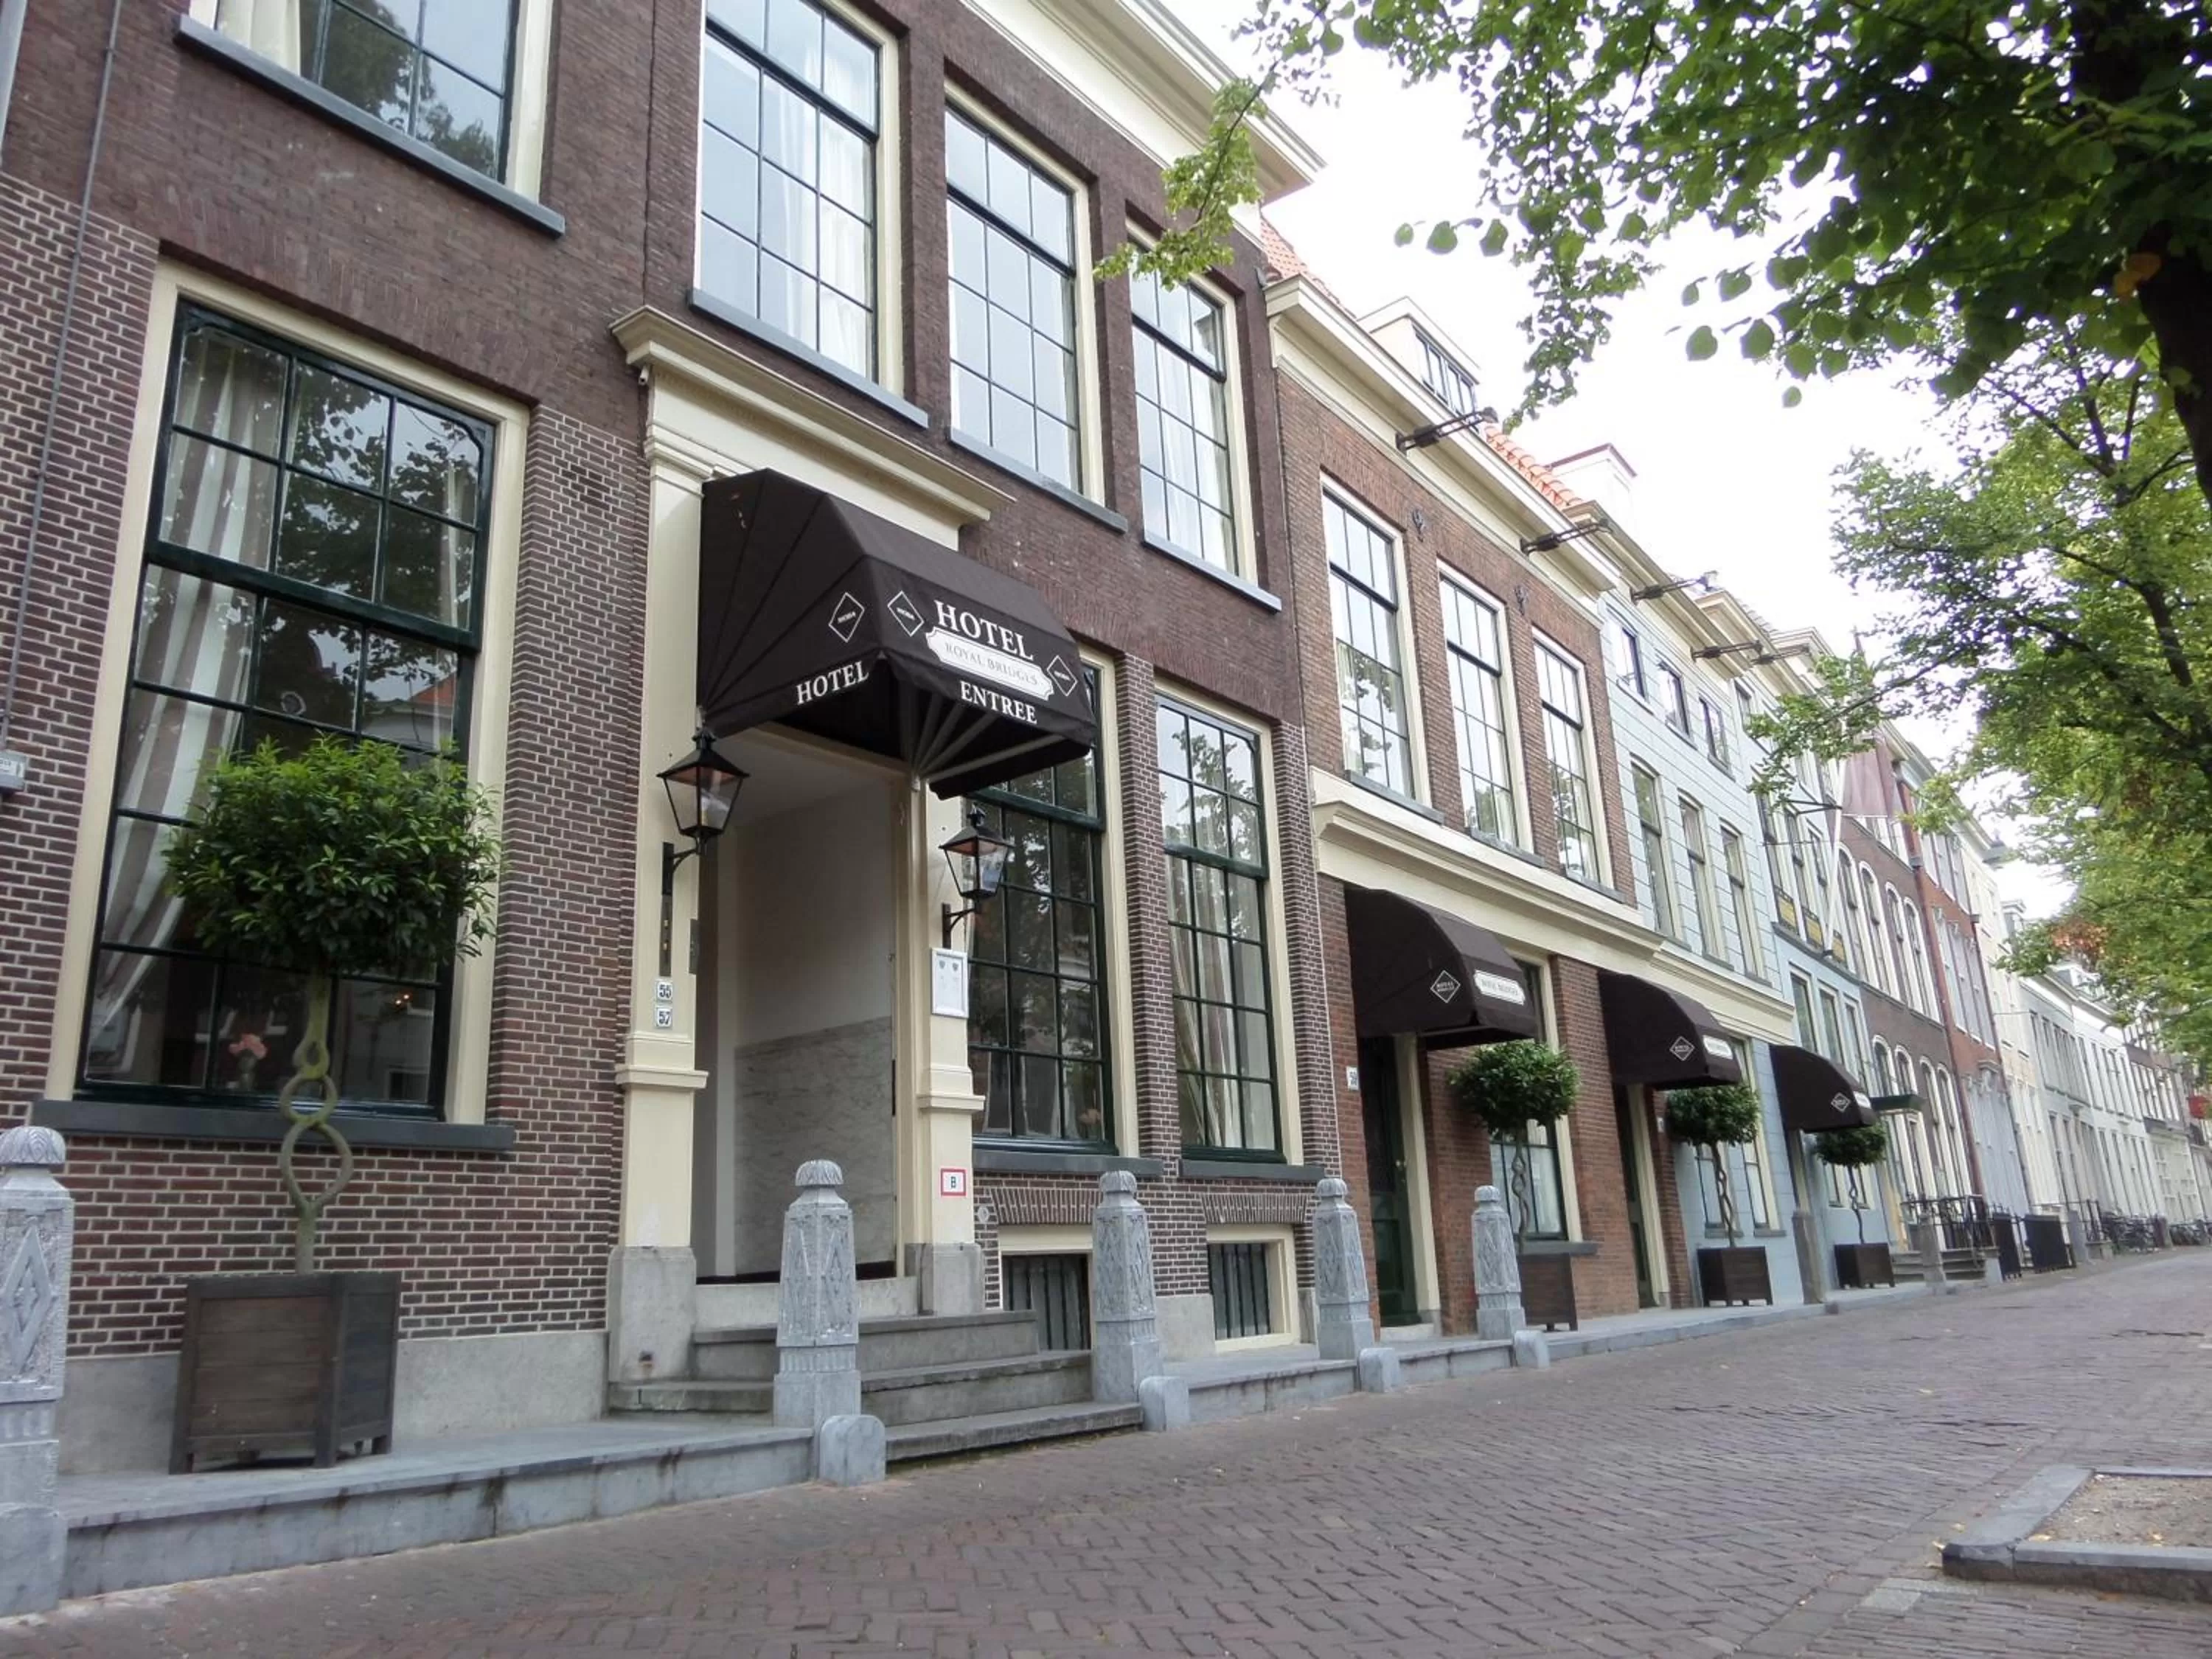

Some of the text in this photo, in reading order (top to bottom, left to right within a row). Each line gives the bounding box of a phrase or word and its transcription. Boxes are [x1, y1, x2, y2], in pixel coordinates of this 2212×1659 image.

[934, 599, 1034, 661] HOTEL
[796, 661, 869, 705] HOTEL
[960, 681, 1037, 724] ENTREE
[659, 984, 672, 998] 55
[658, 1011, 670, 1024] 57
